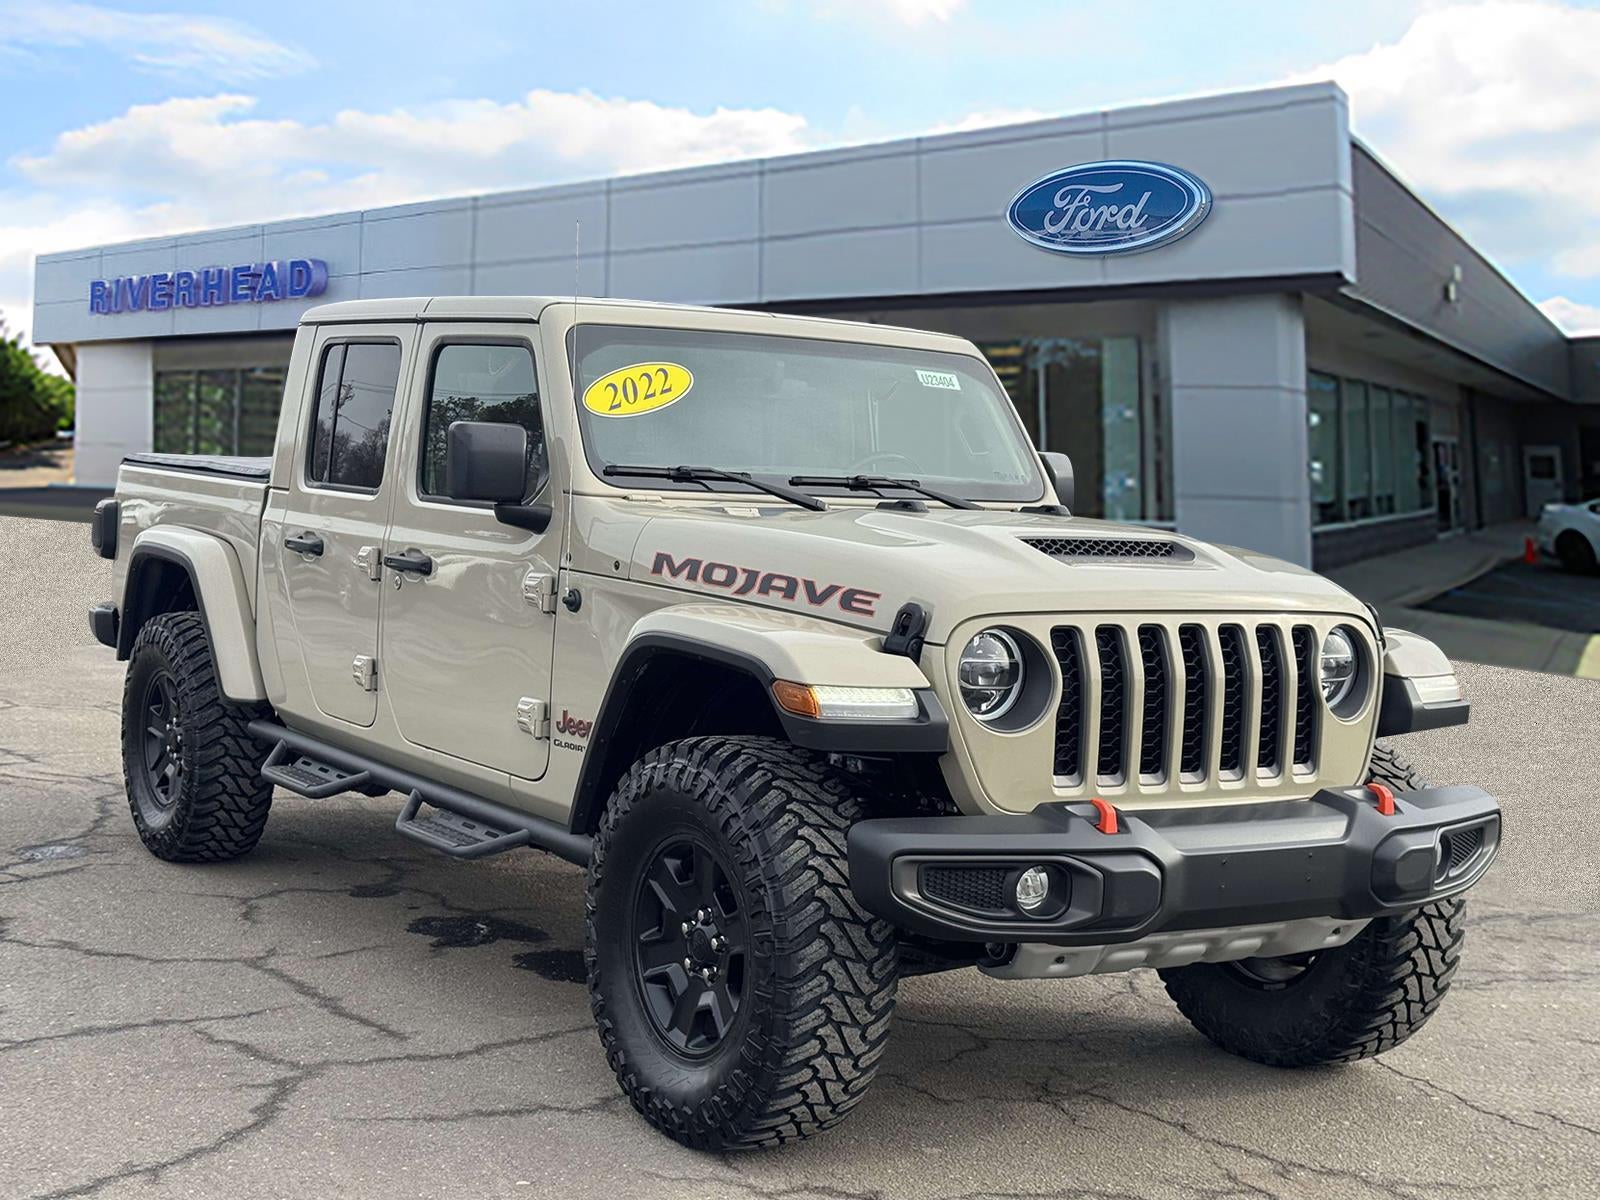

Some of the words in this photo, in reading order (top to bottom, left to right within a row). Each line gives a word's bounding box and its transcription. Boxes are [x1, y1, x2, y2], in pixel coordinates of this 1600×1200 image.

[1044, 183, 1152, 234] Ford
[89, 258, 323, 314] RIVERHEAD
[604, 367, 673, 412] 2022
[920, 373, 956, 388] U23404
[651, 551, 882, 618] MOJAVE
